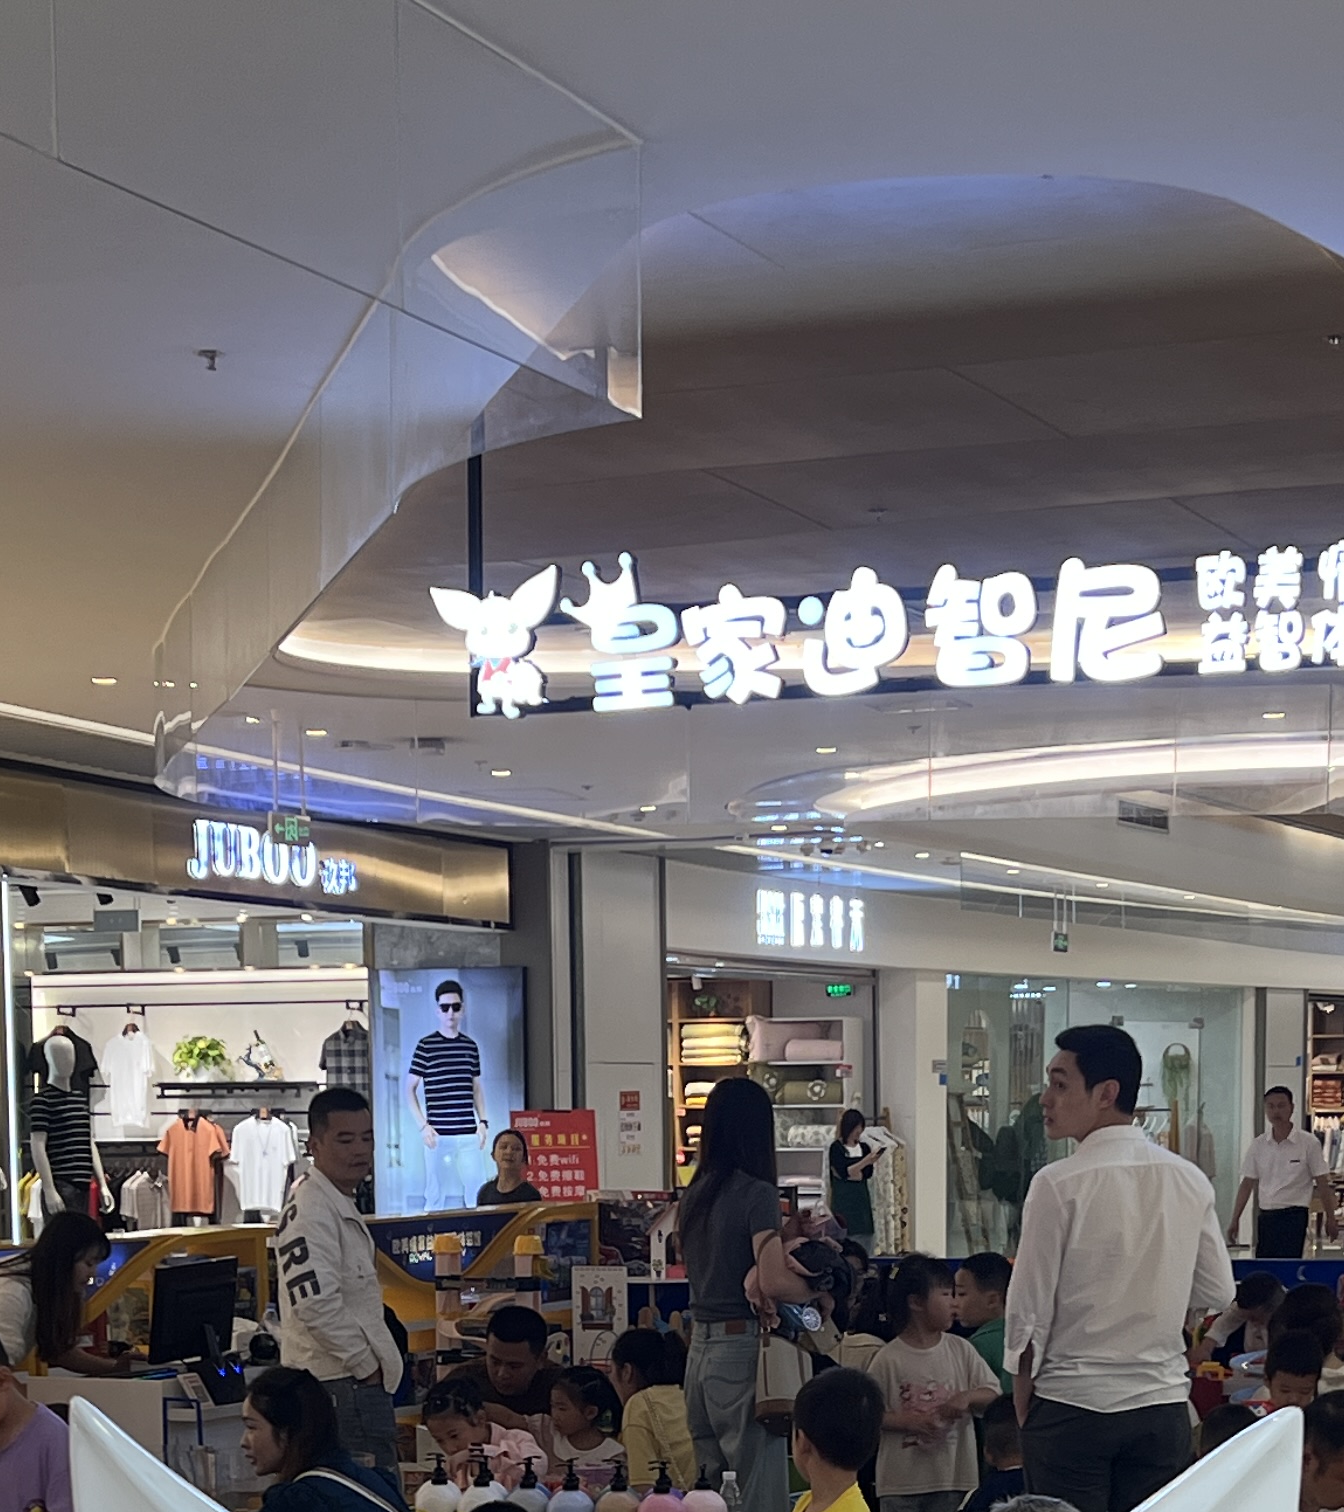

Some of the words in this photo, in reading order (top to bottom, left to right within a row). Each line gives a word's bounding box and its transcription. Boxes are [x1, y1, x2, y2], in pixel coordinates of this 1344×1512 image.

[560, 551, 1165, 713] 皇家迪智尼
